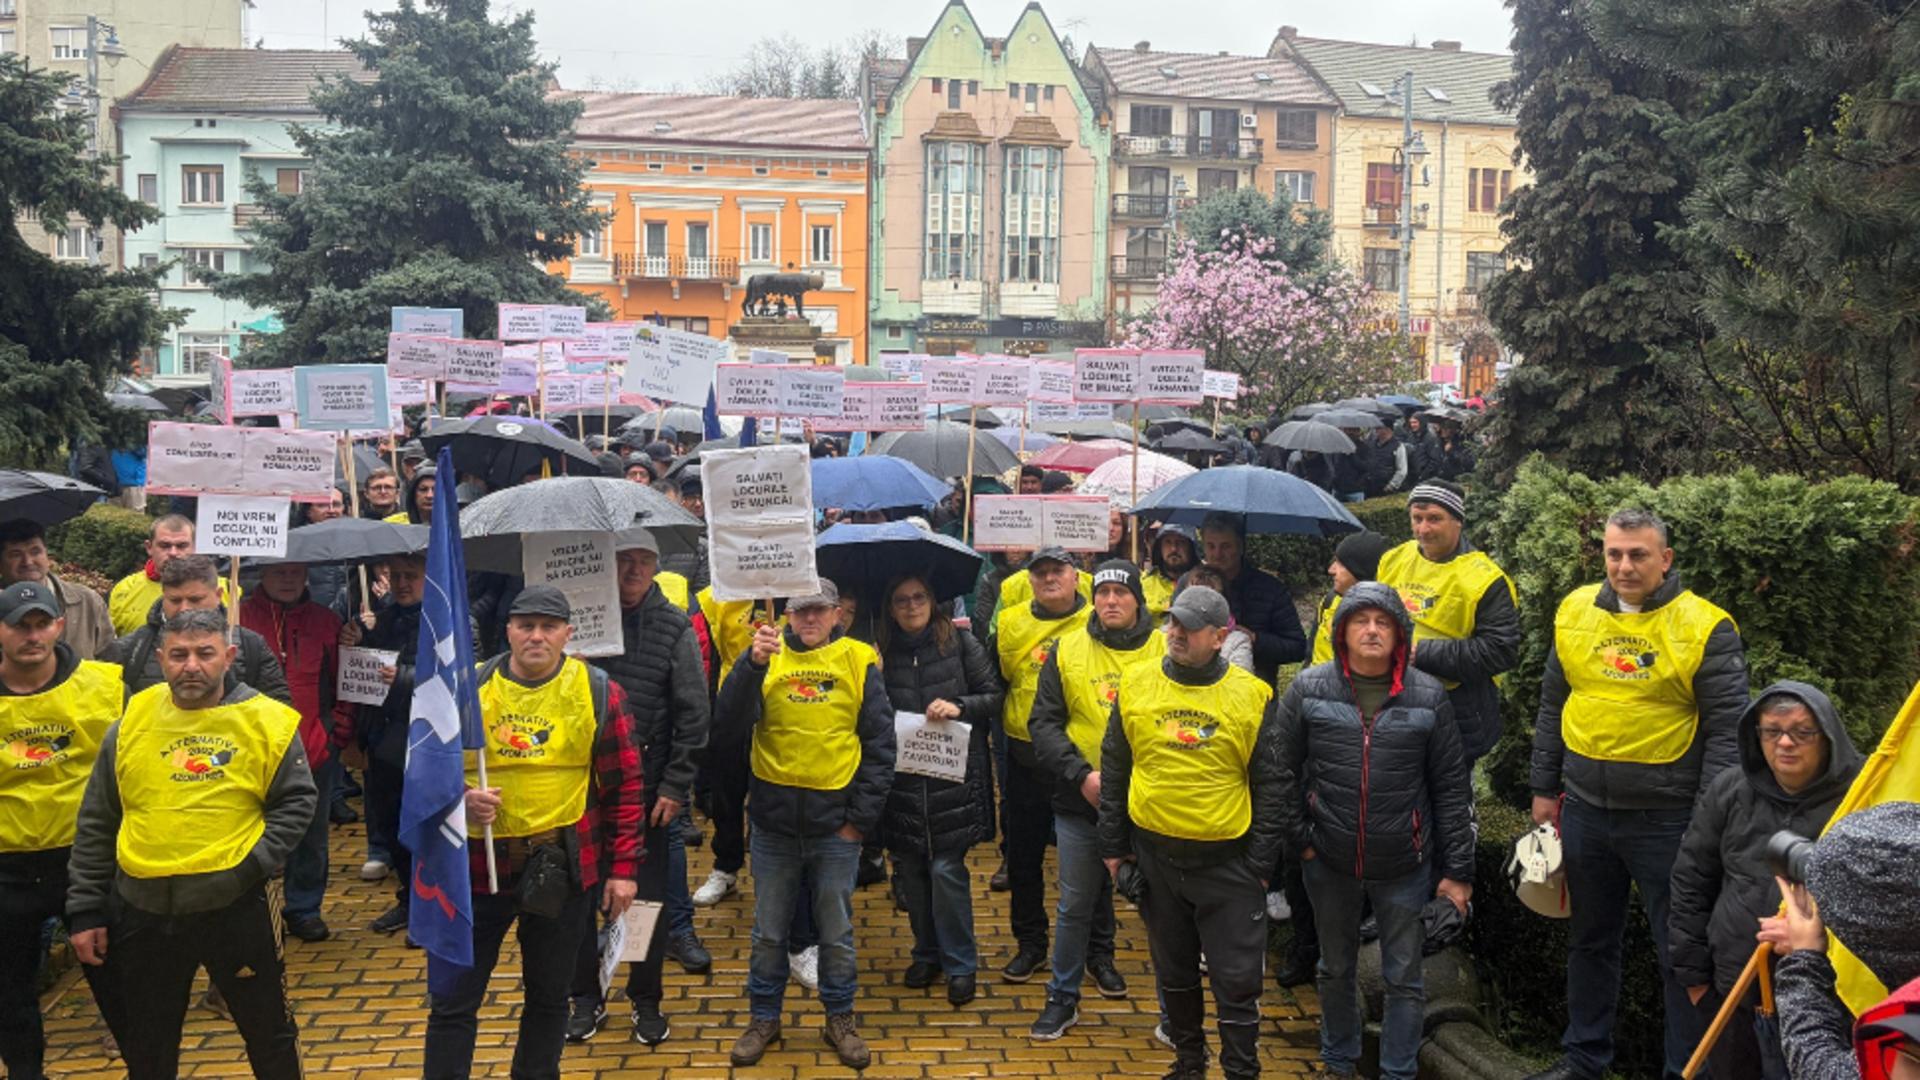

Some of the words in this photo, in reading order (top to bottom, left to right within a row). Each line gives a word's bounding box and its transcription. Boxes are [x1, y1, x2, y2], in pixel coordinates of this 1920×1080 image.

[1082, 372, 1132, 382] LOCURILE
[1080, 384, 1094, 392] DE
[733, 485, 788, 496] LOCURILE
[731, 500, 746, 509] DE
[217, 511, 239, 520] NOI
[242, 511, 276, 522] VREM
[262, 525, 278, 535] NU
[213, 536, 277, 549] CONFLICT!
[489, 713, 555, 733] ALTERNATIVA
[1155, 708, 1220, 728] ALTERNATIVA
[916, 729, 953, 743] CEREM
[160, 735, 239, 758] ALTERNATIVA
[188, 746, 215, 756] 2002
[946, 747, 960, 756] NU
